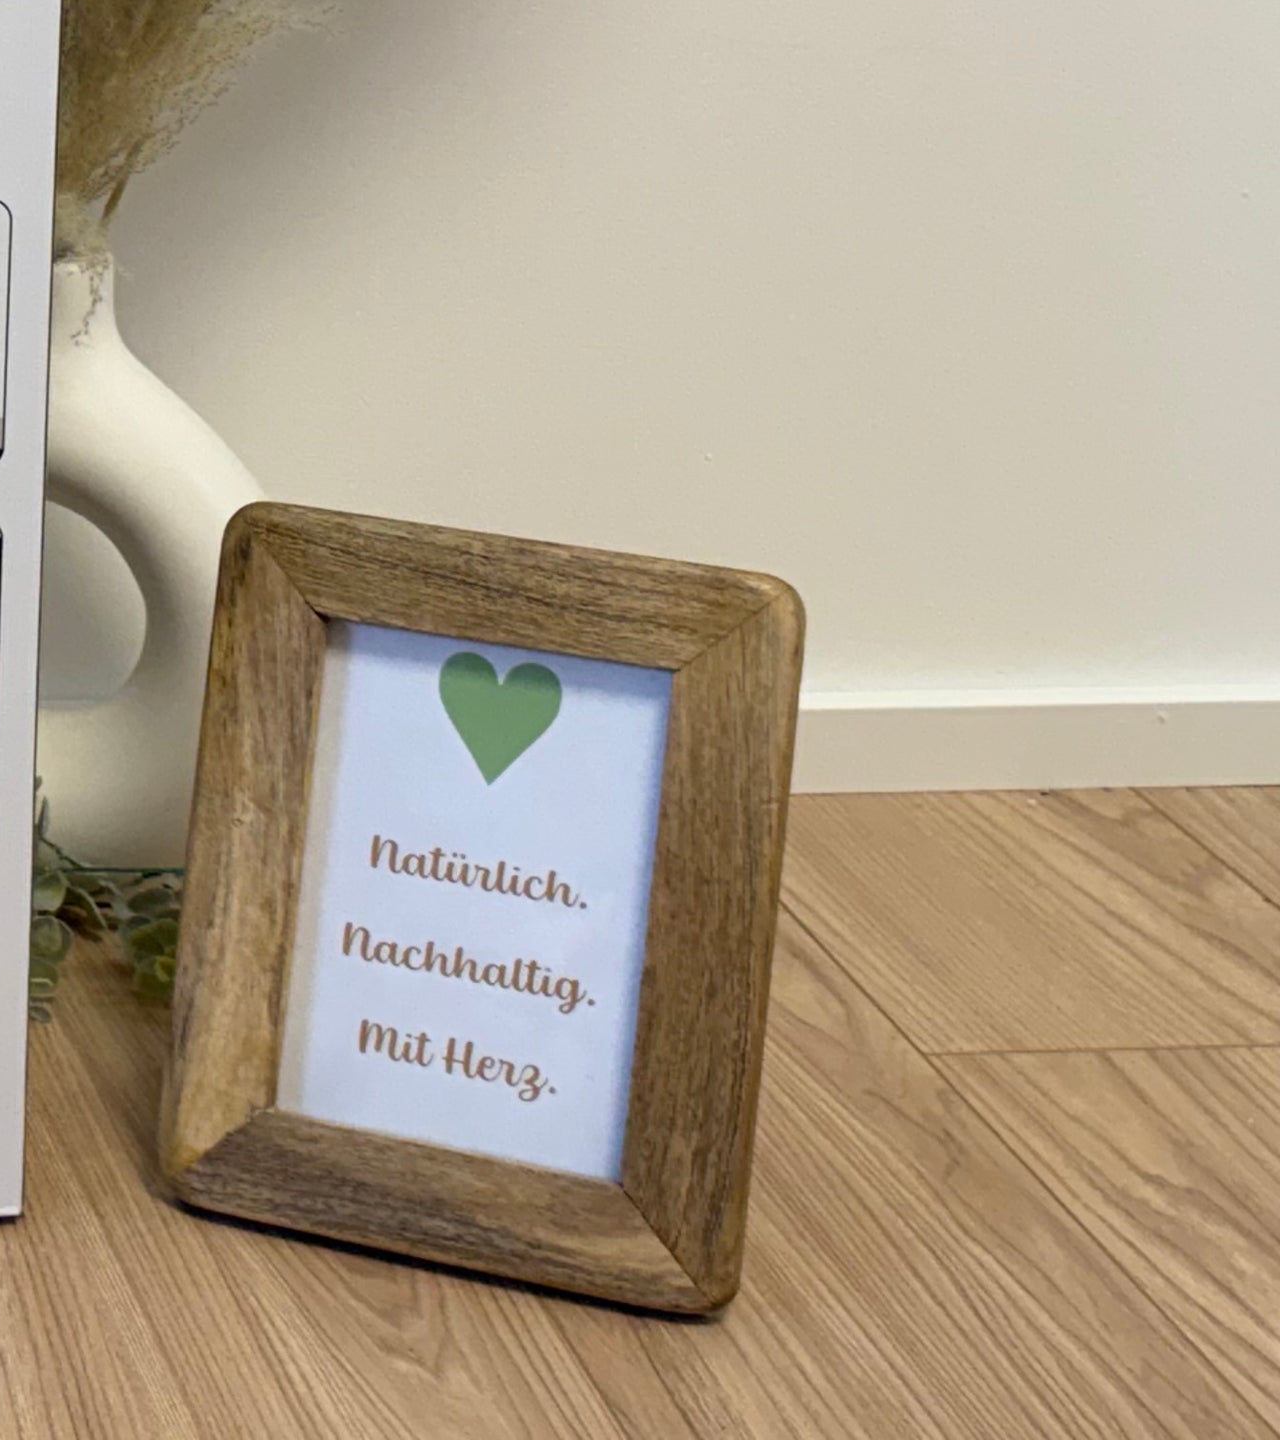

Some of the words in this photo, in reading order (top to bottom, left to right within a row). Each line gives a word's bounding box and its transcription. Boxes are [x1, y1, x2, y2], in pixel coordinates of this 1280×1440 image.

[370, 835, 587, 909] Natürlich.
[343, 922, 595, 1014] Nachhaltig.
[359, 1019, 433, 1067] Mit
[443, 1037, 557, 1102] Herz.
